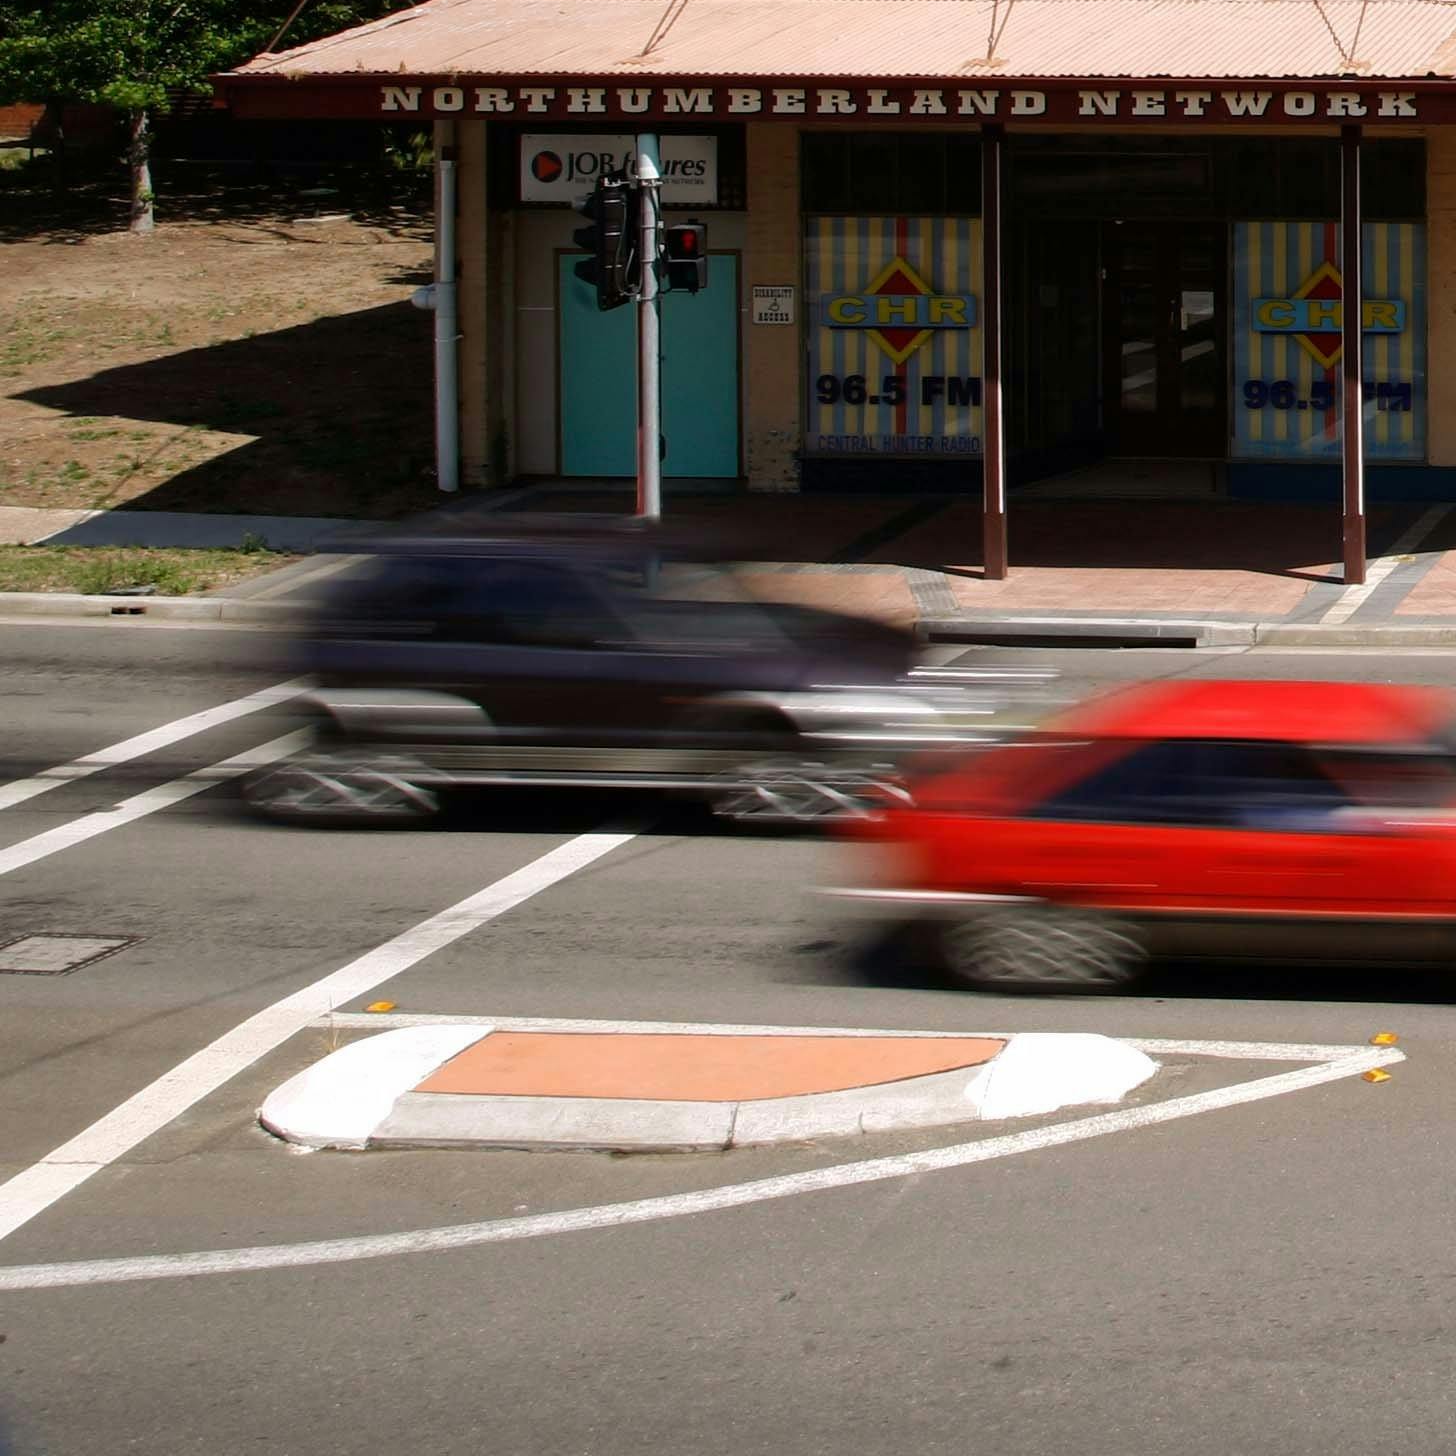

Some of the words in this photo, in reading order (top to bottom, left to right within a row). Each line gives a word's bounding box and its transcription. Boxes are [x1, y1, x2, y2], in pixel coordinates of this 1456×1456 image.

[380, 86, 1048, 118] NORTHUMBERLAND
[1079, 89, 1418, 118] NETWORK
[567, 151, 615, 182] JOB
[621, 151, 707, 176] fures
[827, 296, 970, 325] CHR
[1256, 300, 1398, 329] CHR
[815, 375, 908, 405] 96.5
[921, 376, 982, 406] FM
[1243, 379, 1334, 411] 96.5
[818, 435, 877, 452] CENTRAL
[941, 436, 980, 453] RADIO
